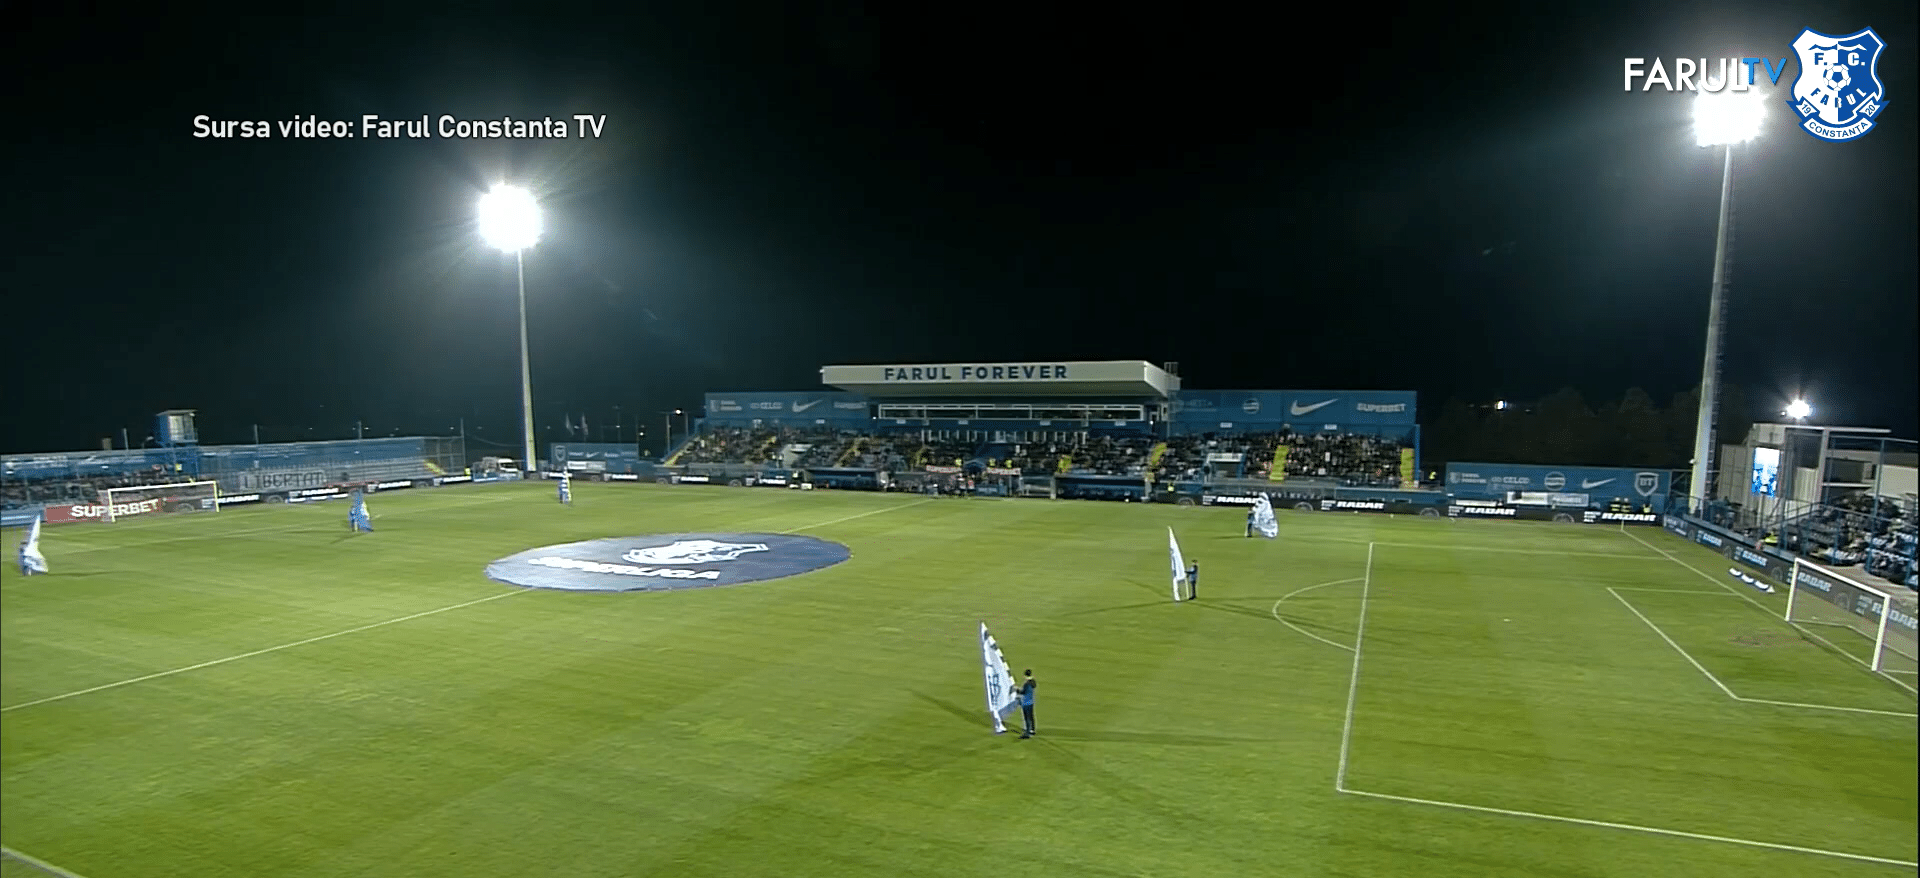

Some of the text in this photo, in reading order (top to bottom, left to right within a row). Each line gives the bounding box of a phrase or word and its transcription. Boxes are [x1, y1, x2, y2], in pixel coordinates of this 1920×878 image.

[884, 365, 1068, 381] FARUL FOREVER
[1640, 477, 1653, 487] BT
[71, 498, 159, 518] SUPERBET
[1336, 501, 1385, 509] RADAR
[1464, 507, 1517, 516] RADAR
[1601, 512, 1657, 522] RADAR
[1797, 572, 1832, 593] RADAR
